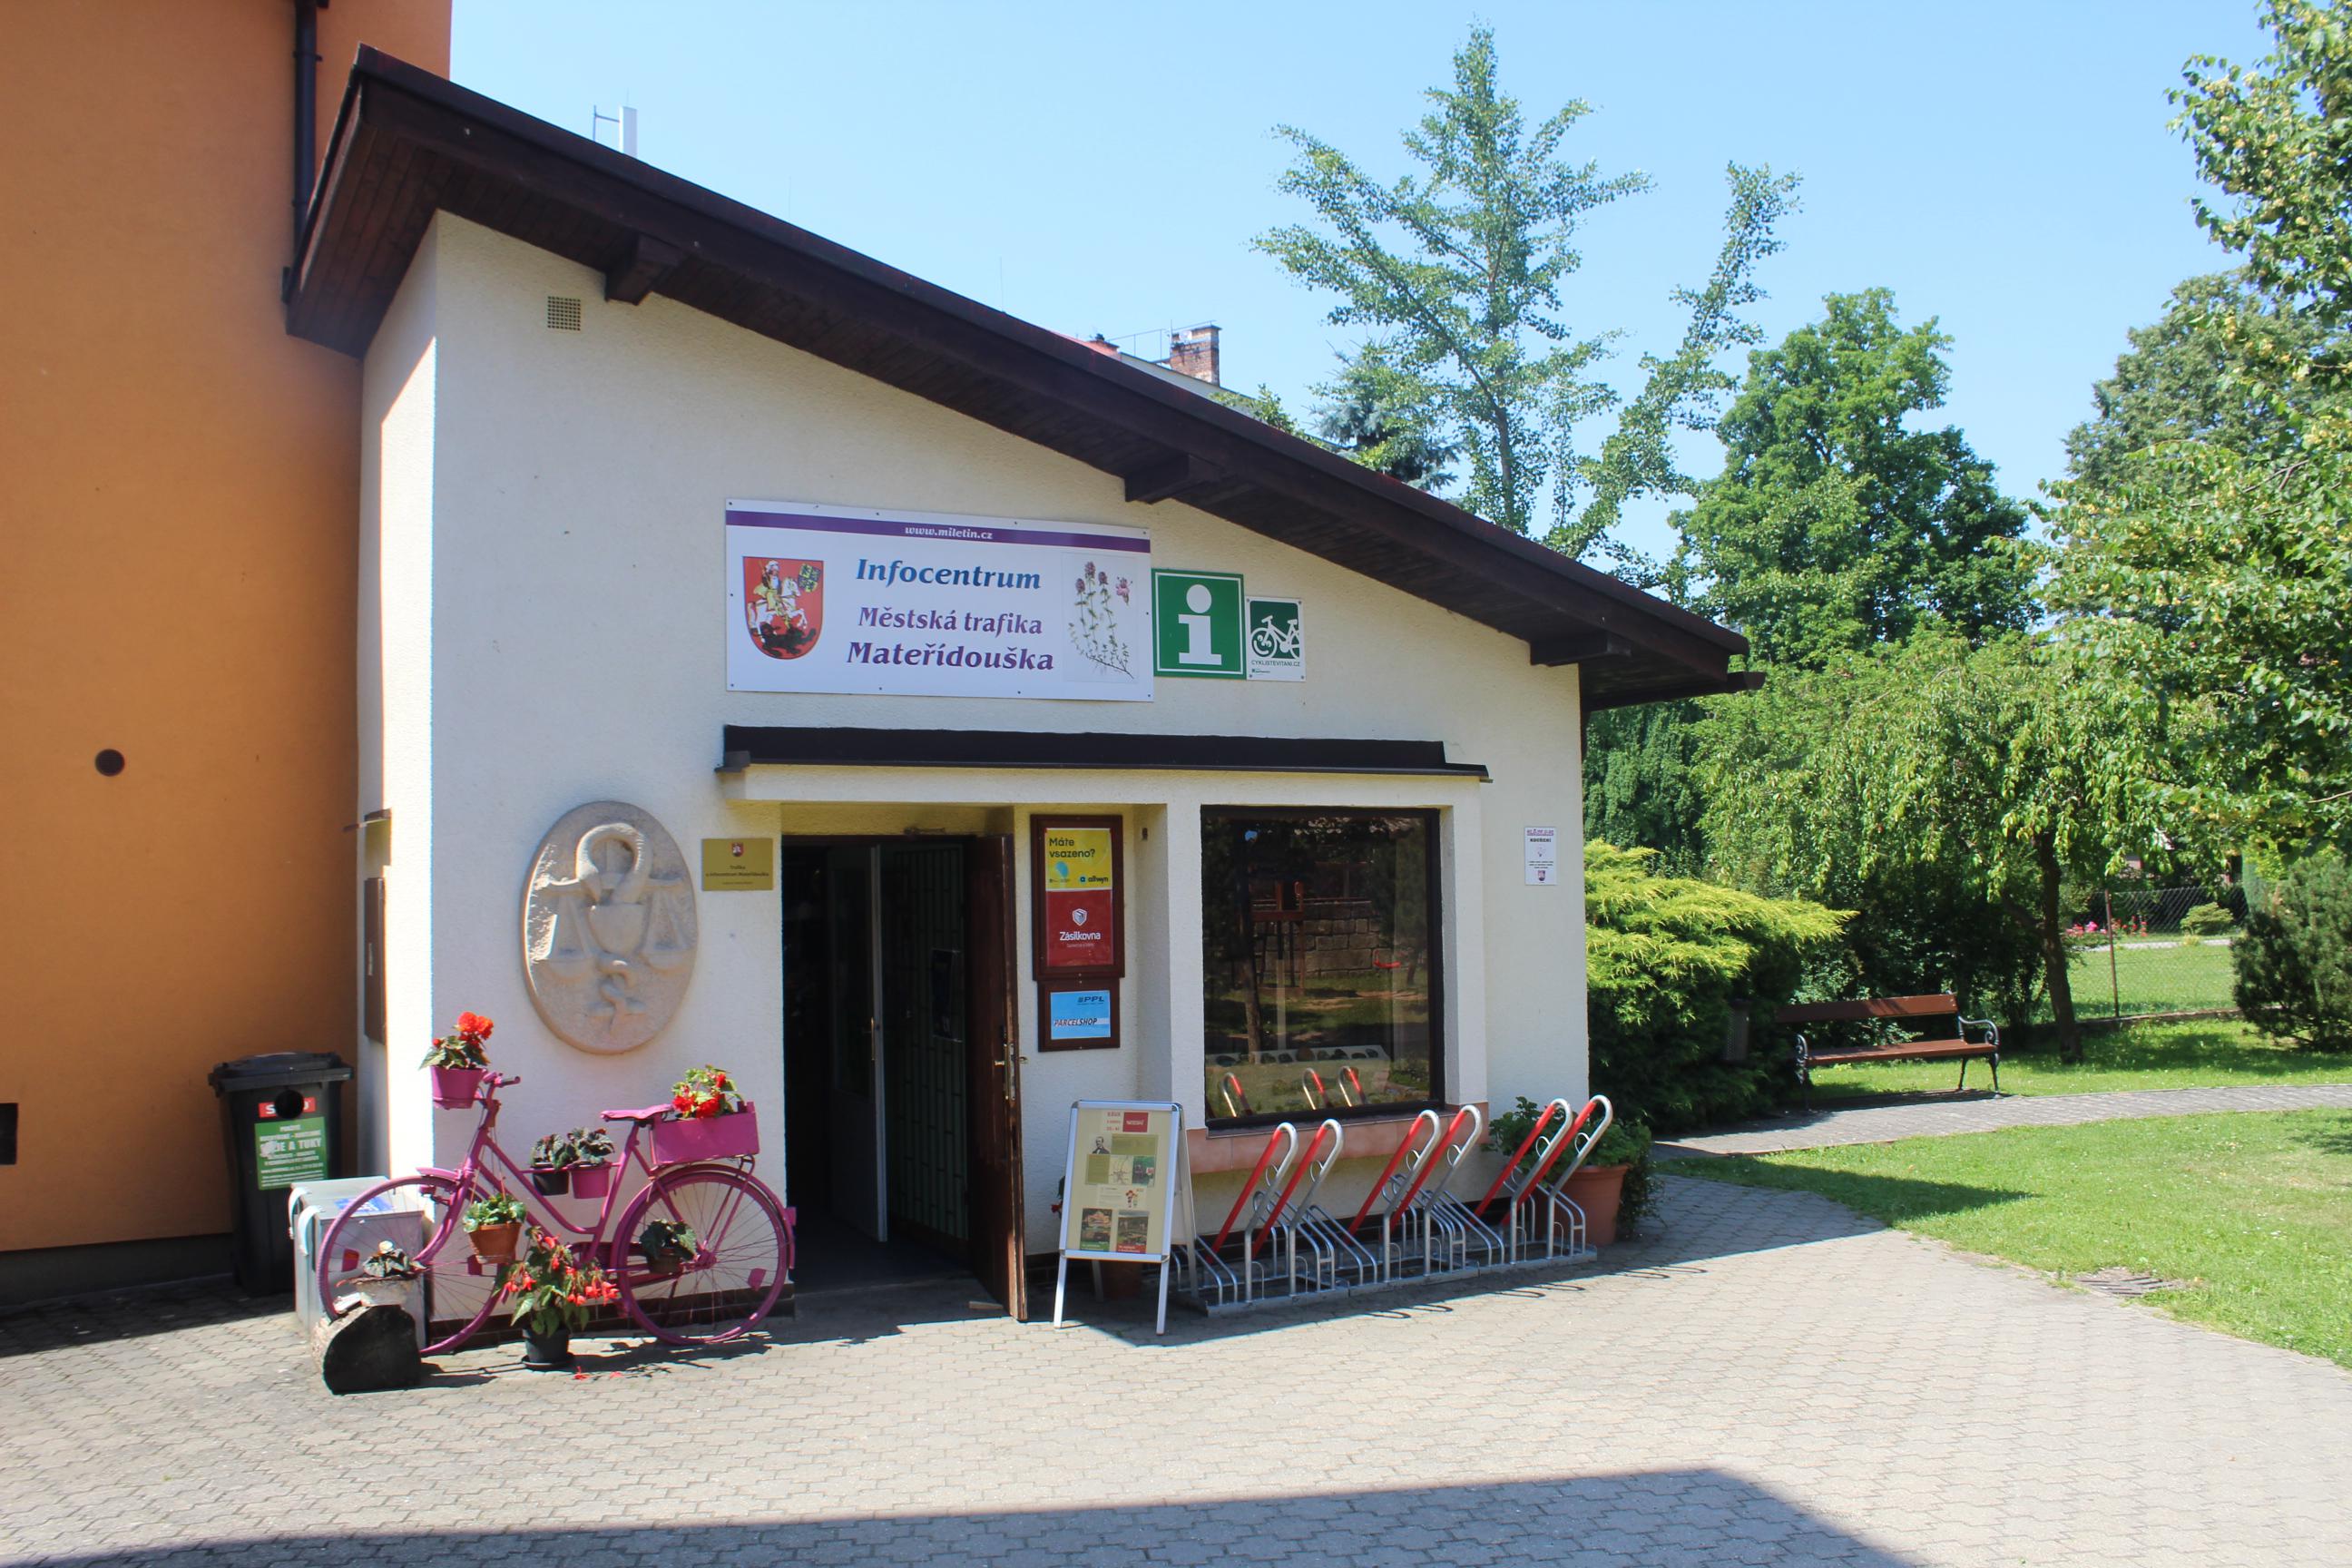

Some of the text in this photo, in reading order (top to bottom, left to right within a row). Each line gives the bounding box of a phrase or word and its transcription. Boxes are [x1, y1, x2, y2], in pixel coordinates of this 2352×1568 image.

[905, 526, 993, 540] www.miletin.cz
[856, 558, 1042, 590] Infocentrum
[858, 606, 1043, 638] Městská trafika
[847, 642, 1054, 671] Mateřídouška
[1049, 838, 1074, 847] Máte
[1049, 848, 1095, 858] vsazeno?
[1059, 931, 1101, 941] Zásilkovna
[1054, 1018, 1098, 1026] PARCELSHOP
